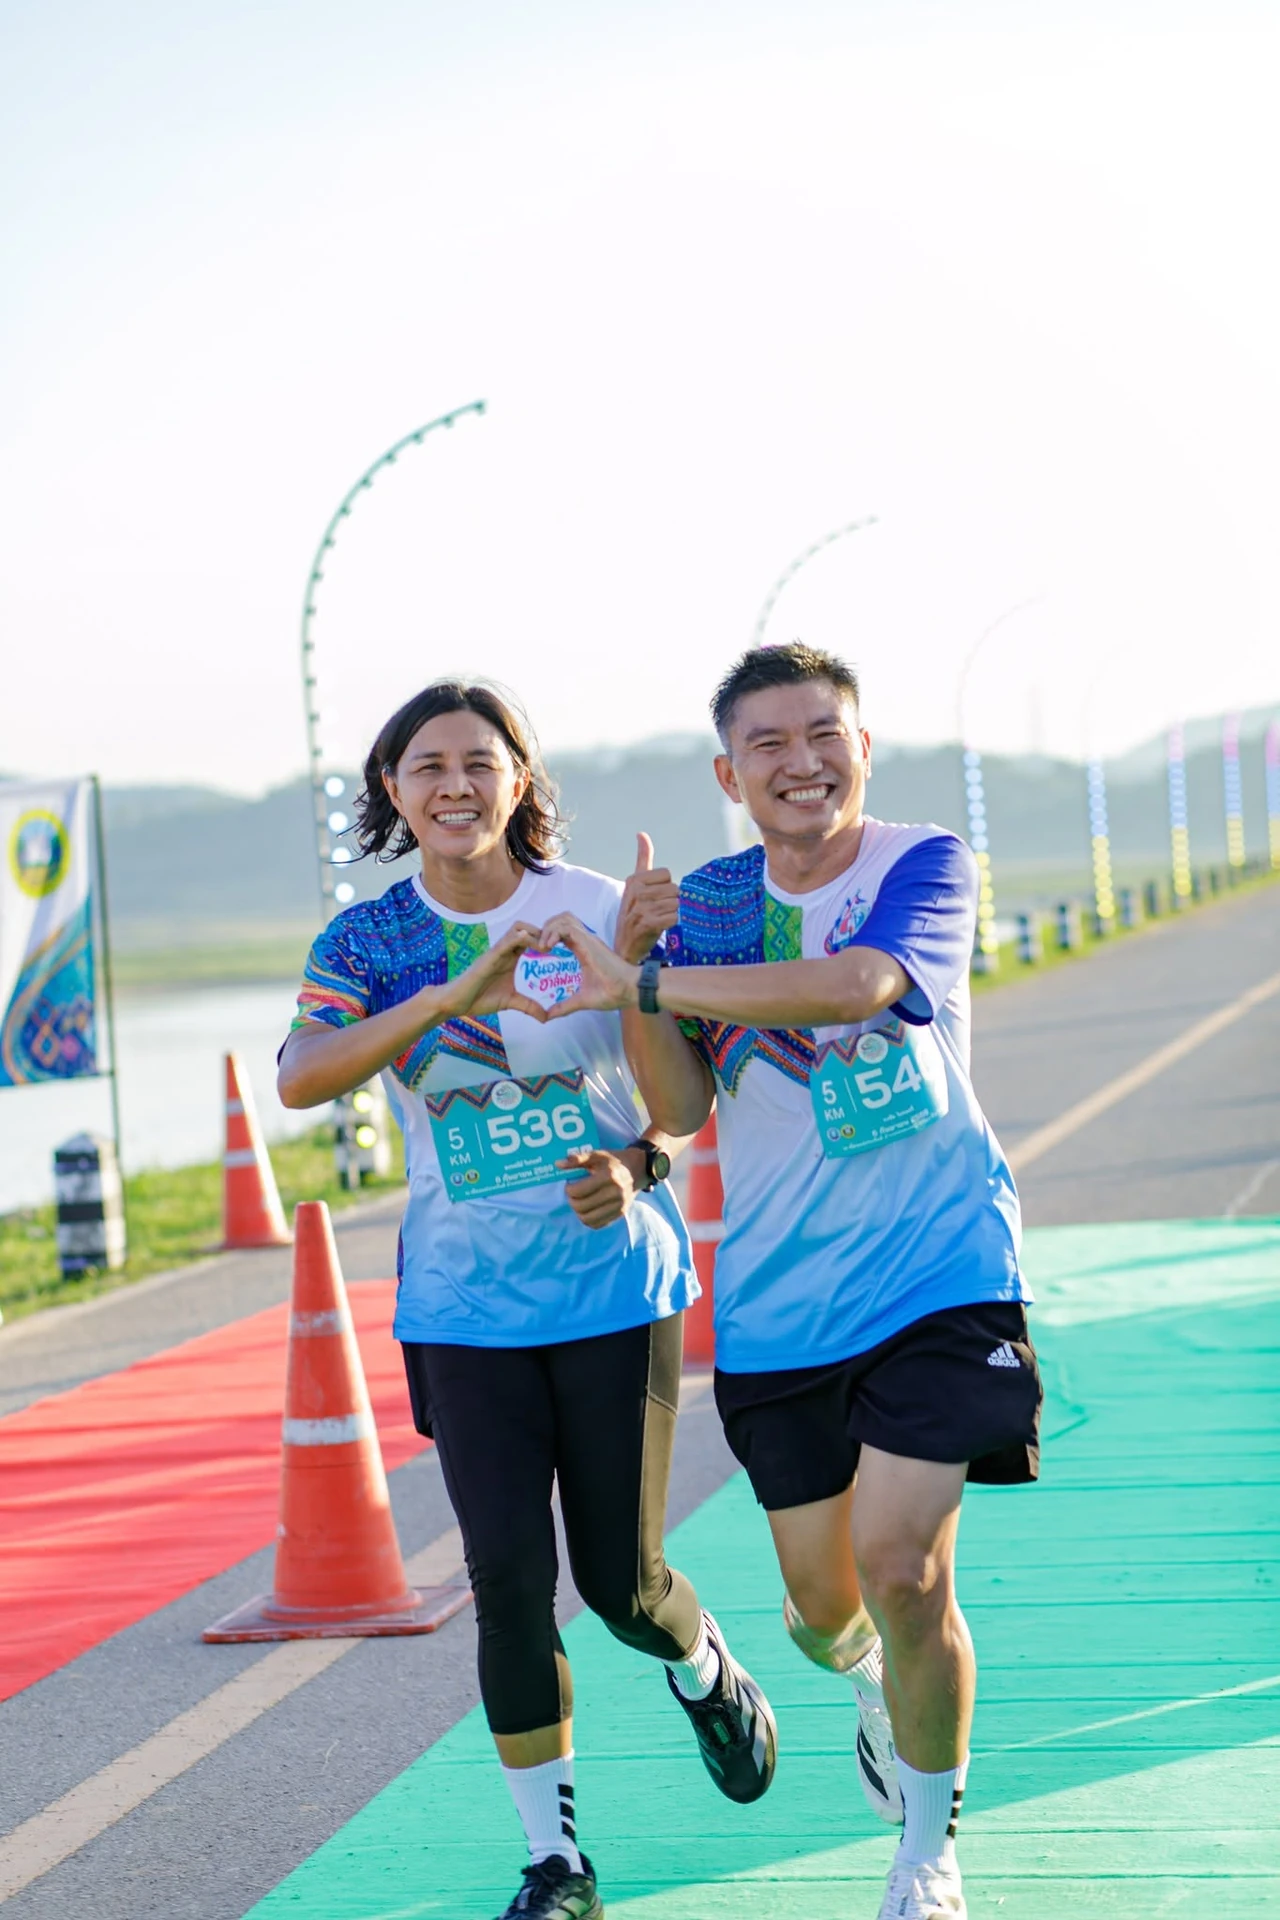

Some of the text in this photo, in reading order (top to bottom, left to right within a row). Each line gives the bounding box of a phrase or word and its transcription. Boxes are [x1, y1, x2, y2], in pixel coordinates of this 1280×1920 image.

[822, 1080, 837, 1105] 5
[824, 1106, 846, 1122] KM
[448, 1127, 464, 1150] 5
[486, 1103, 586, 1155] 536
[449, 1152, 472, 1167] KM
[987, 1356, 1021, 1368] adidas
